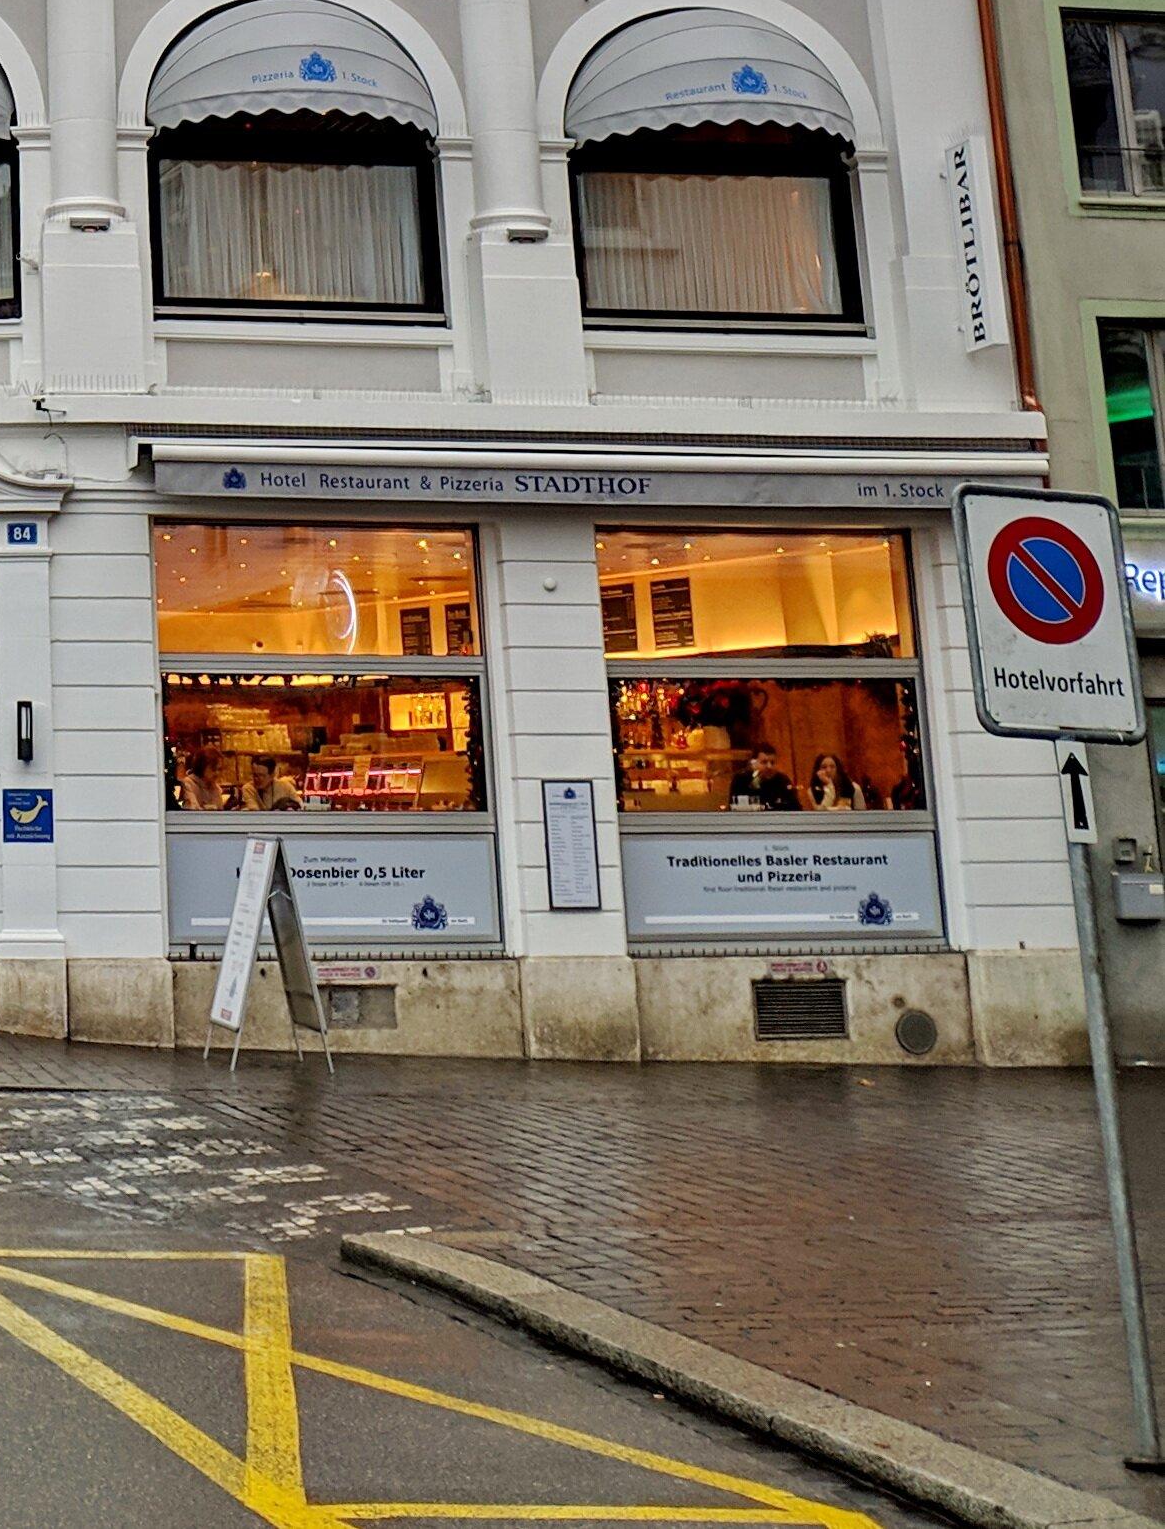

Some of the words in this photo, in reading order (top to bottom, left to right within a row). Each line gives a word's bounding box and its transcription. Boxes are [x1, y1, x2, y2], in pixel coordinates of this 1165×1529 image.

[251, 72, 294, 84] Pizzeria
[351, 73, 378, 87] Stock
[665, 83, 727, 100] Restaurant
[783, 86, 807, 99] Stock
[954, 146, 985, 343] BRÖTLIBAR
[261, 473, 306, 487] Hotel
[320, 474, 410, 490] Restaurant
[420, 475, 432, 490] &
[440, 476, 504, 492] Pizzeria
[515, 475, 652, 495] STADTHOF
[857, 483, 877, 497] im
[883, 483, 896, 497] 1.
[900, 483, 945, 498] Stock
[13, 527, 31, 541] 84
[993, 667, 1125, 697] Hotelvorfahrt
[667, 854, 762, 868] Traditionelles
[766, 854, 809, 867] Basler
[813, 854, 889, 866] Restaurant
[364, 866, 387, 881] 0,5
[392, 866, 426, 879] Liter
[738, 871, 763, 883] und
[768, 871, 822, 883] Pizzeria
